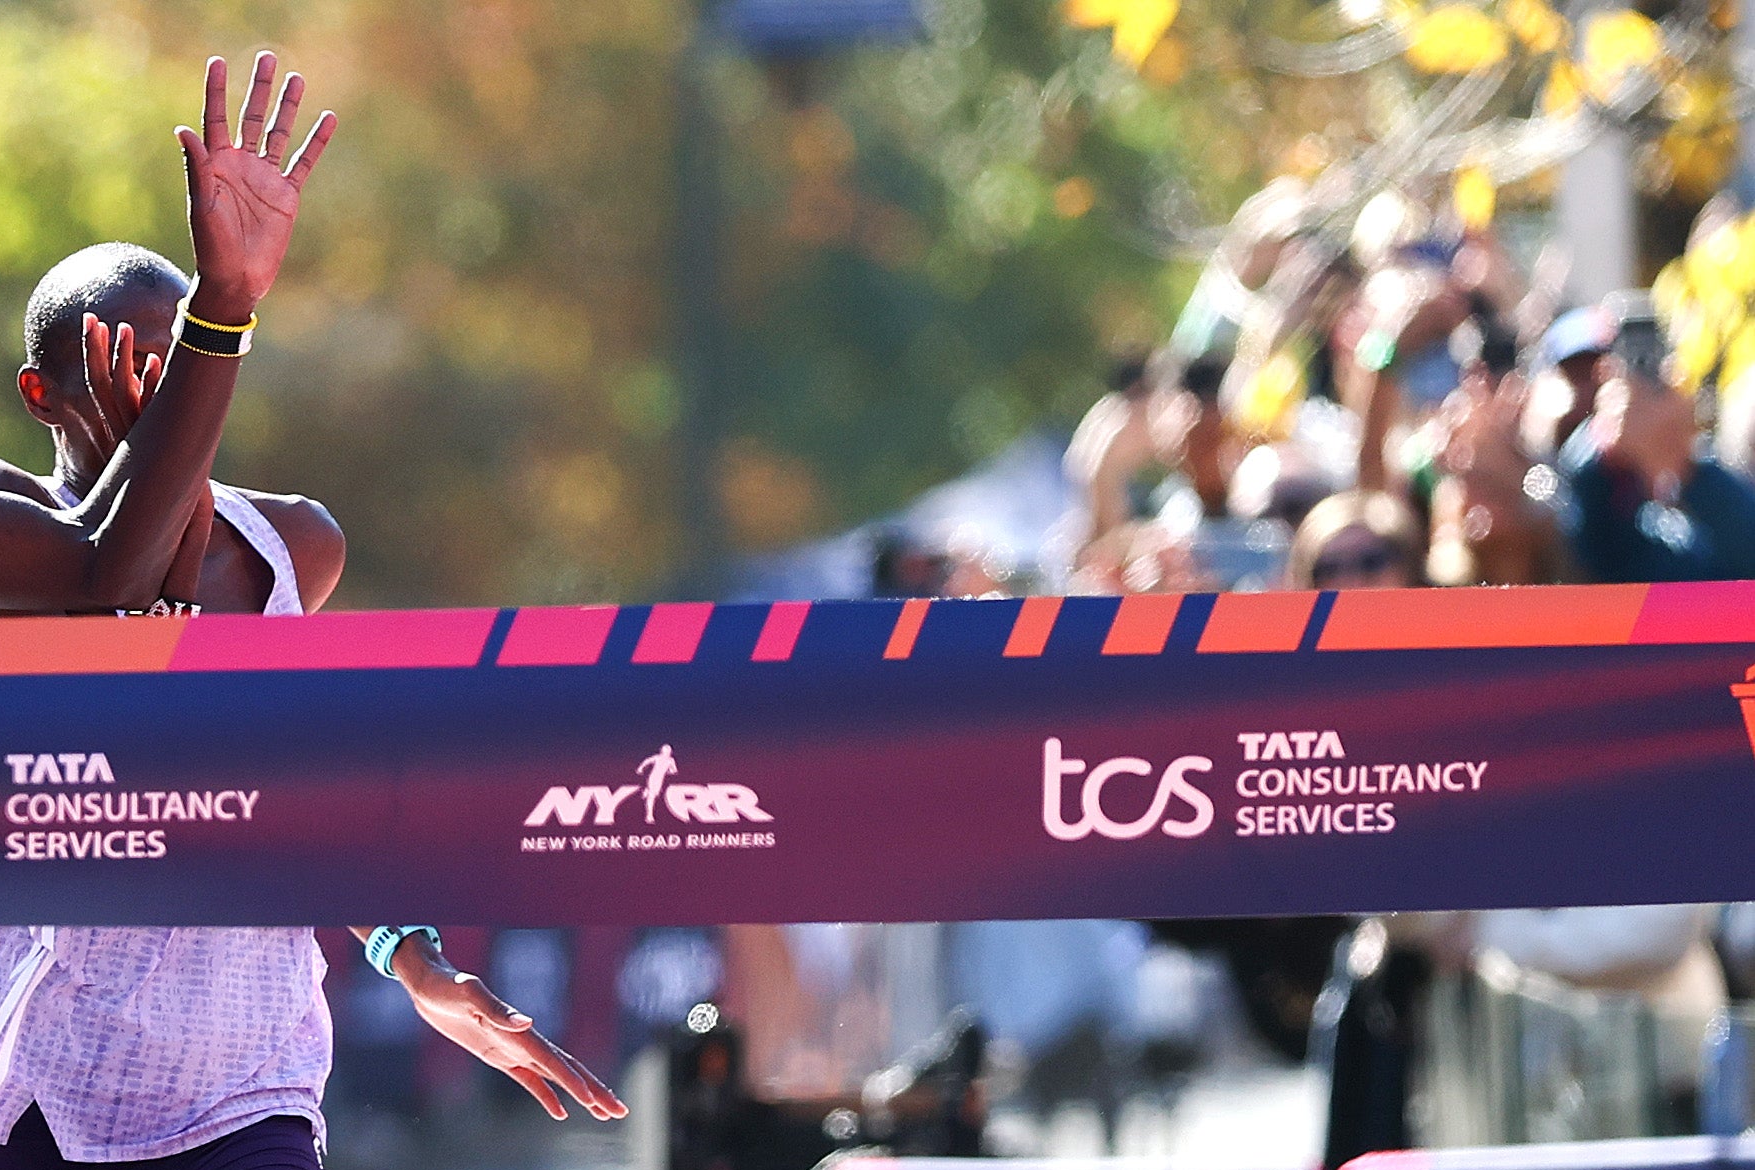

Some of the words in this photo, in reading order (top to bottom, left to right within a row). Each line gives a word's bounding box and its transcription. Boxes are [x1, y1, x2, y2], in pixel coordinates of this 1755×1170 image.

[1237, 730, 1346, 761] TATA
[5, 752, 115, 785] TATA
[1236, 761, 1489, 798] CONSULTANCY
[1043, 737, 1215, 841] tcs
[5, 789, 260, 824] CONSULTANCY
[1236, 802, 1397, 837] SERVICES
[5, 830, 167, 860] SERVICES
[521, 835, 566, 852] NEW
[570, 834, 622, 851] YORK
[628, 833, 681, 850] ROAD
[686, 832, 776, 849] RUNNERS
